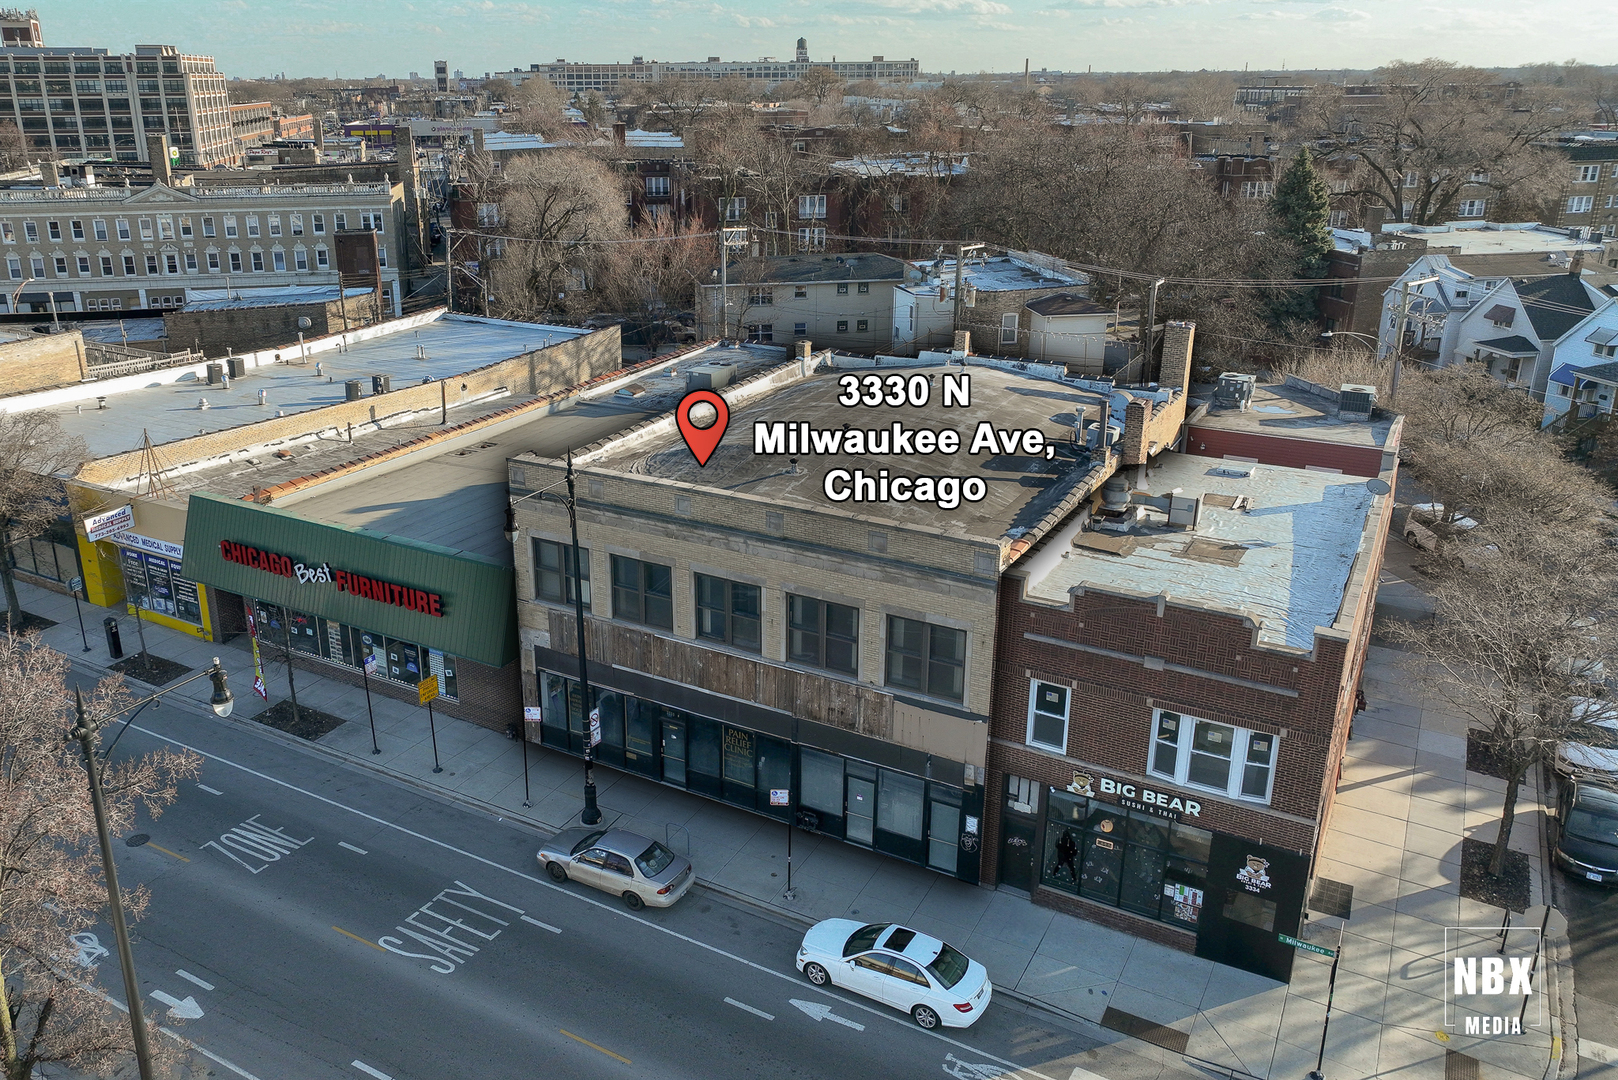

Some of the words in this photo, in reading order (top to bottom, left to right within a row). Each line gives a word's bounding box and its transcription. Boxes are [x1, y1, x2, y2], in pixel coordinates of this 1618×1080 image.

[92, 509, 126, 525] Advanced
[113, 532, 139, 545] ADVANCED
[141, 537, 163, 551] MEDICAL
[164, 544, 181, 556] SUPPLY
[220, 540, 293, 578] CHICAGO
[294, 563, 332, 584] Best
[335, 570, 443, 618] FURNITURE
[725, 735, 751, 749] RELIEF
[728, 728, 748, 740] PAIN
[724, 743, 753, 757] CLINIC
[1100, 778, 1136, 798] BIG
[1142, 789, 1201, 817] BEAR
[1121, 799, 1145, 811] SUSHI
[1158, 809, 1177, 819] THAI
[199, 814, 315, 874] ZONE
[1236, 873, 1249, 882] BIG
[1251, 878, 1271, 889] BEAR
[1245, 884, 1260, 893] 3334
[378, 880, 525, 974] SAFETY
[1286, 937, 1325, 954] Milwaukee
